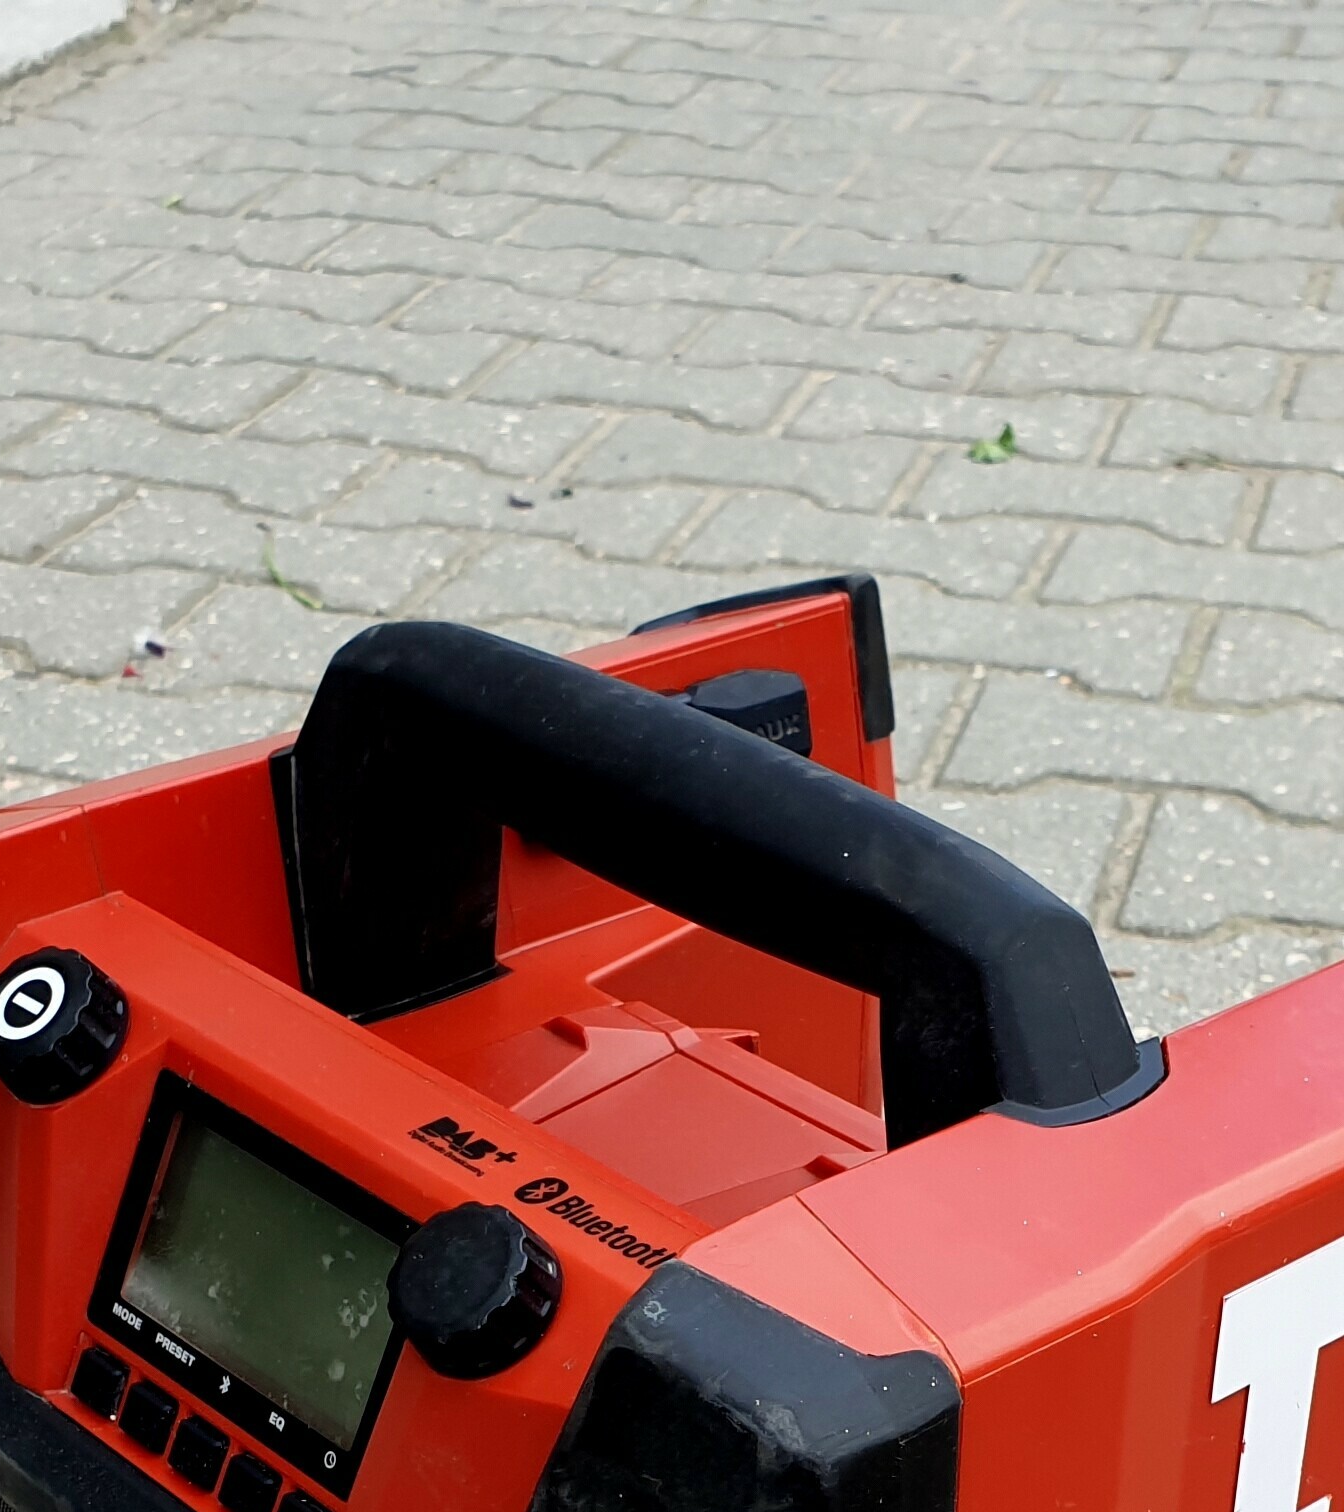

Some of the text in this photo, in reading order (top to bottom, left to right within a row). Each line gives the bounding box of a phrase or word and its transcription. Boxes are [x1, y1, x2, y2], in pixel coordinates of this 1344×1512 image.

[417, 1115, 518, 1164] DAB+
[112, 1302, 144, 1331] MODE
[155, 1332, 197, 1368] PRESET
[268, 1411, 286, 1432] EQ
